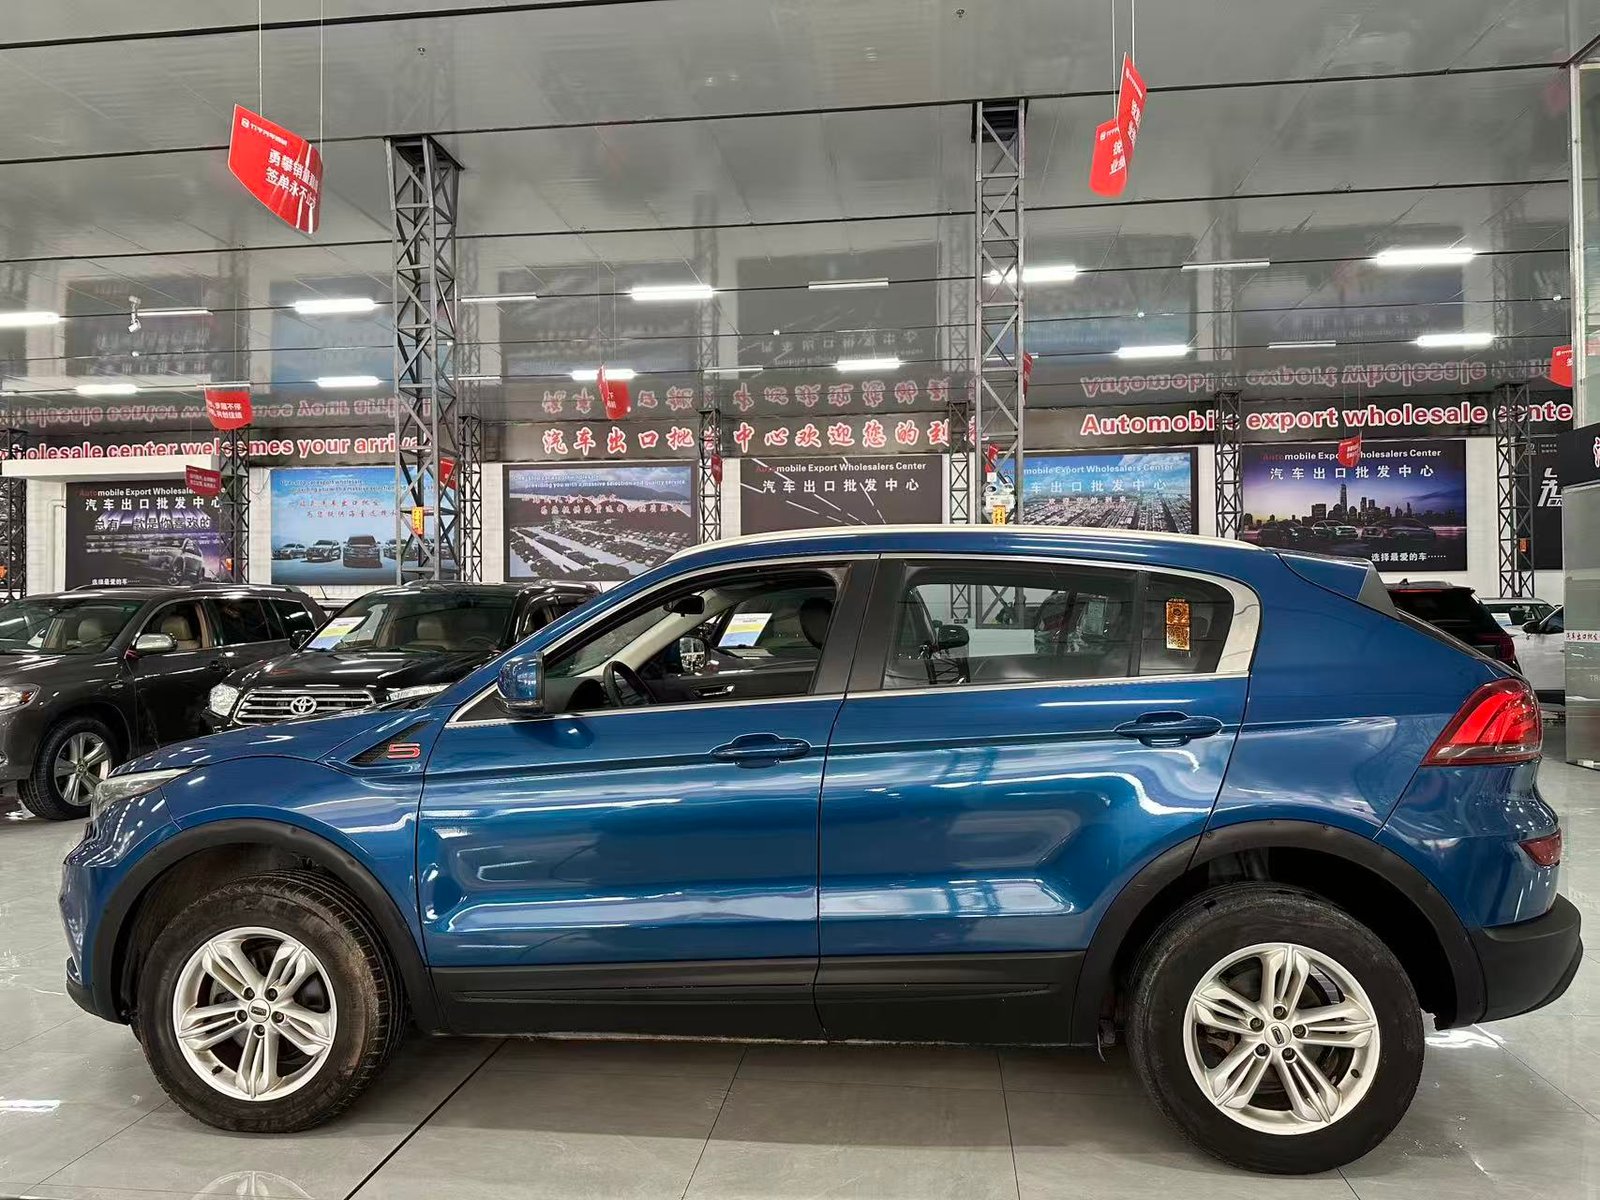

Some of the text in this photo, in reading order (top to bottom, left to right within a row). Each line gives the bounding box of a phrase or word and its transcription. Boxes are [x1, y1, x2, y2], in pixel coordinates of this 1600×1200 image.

[1246, 407, 1338, 433] export
[1341, 401, 1488, 429] wholesale
[1492, 400, 1573, 422] cente
[106, 440, 177, 458] center
[297, 436, 351, 459] your
[1360, 450, 1408, 459] holesalers
[1410, 449, 1442, 458] Center
[808, 463, 838, 473] Export
[839, 462, 895, 472] Wholesalers
[896, 461, 927, 471] Center
[1055, 466, 1085, 475] Export
[1086, 464, 1142, 474] Wholesalers
[1270, 465, 1434, 480] 汽车出口批发中心
[125, 487, 151, 497] Export
[152, 486, 196, 496] Wholesale
[762, 478, 920, 494] 汽车出口批发中心
[1030, 479, 1167, 494] 车出口批发中心
[85, 498, 222, 512] 汽车出口批发中心
[94, 516, 212, 531] 总有一款是你喜欢的
